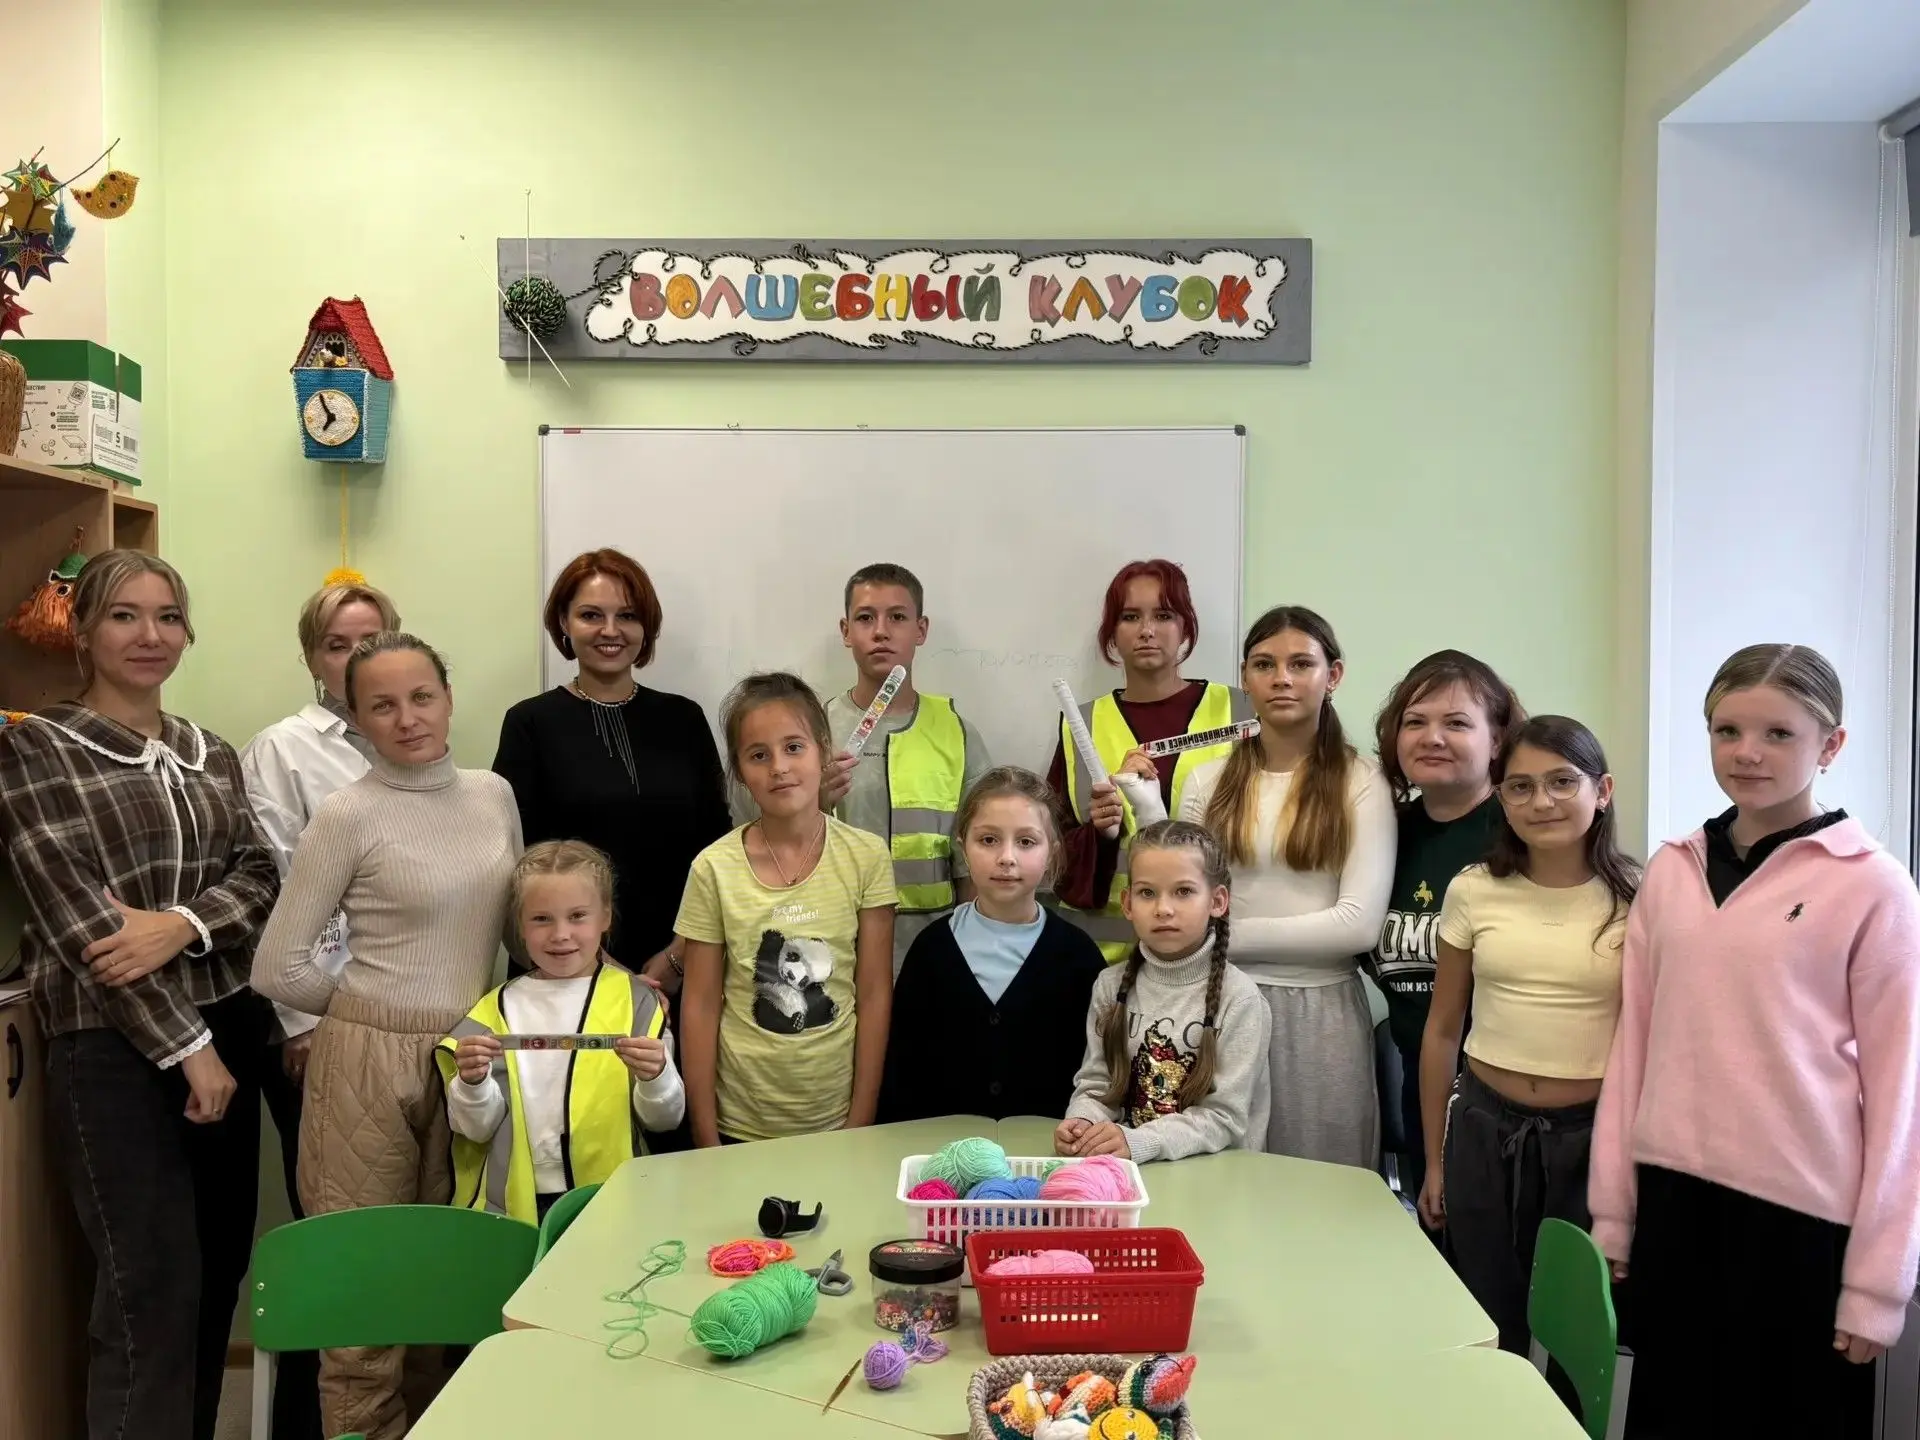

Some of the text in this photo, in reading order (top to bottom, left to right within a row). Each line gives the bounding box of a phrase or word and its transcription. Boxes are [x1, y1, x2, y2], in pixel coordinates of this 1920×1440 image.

[629, 262, 1253, 327] ВОЛШЕБНЫЙ КЛУБОК
[1155, 741, 1166, 752] ЗА
[1168, 724, 1240, 748] ВЗАИМОУВАЖЕНИЕ
